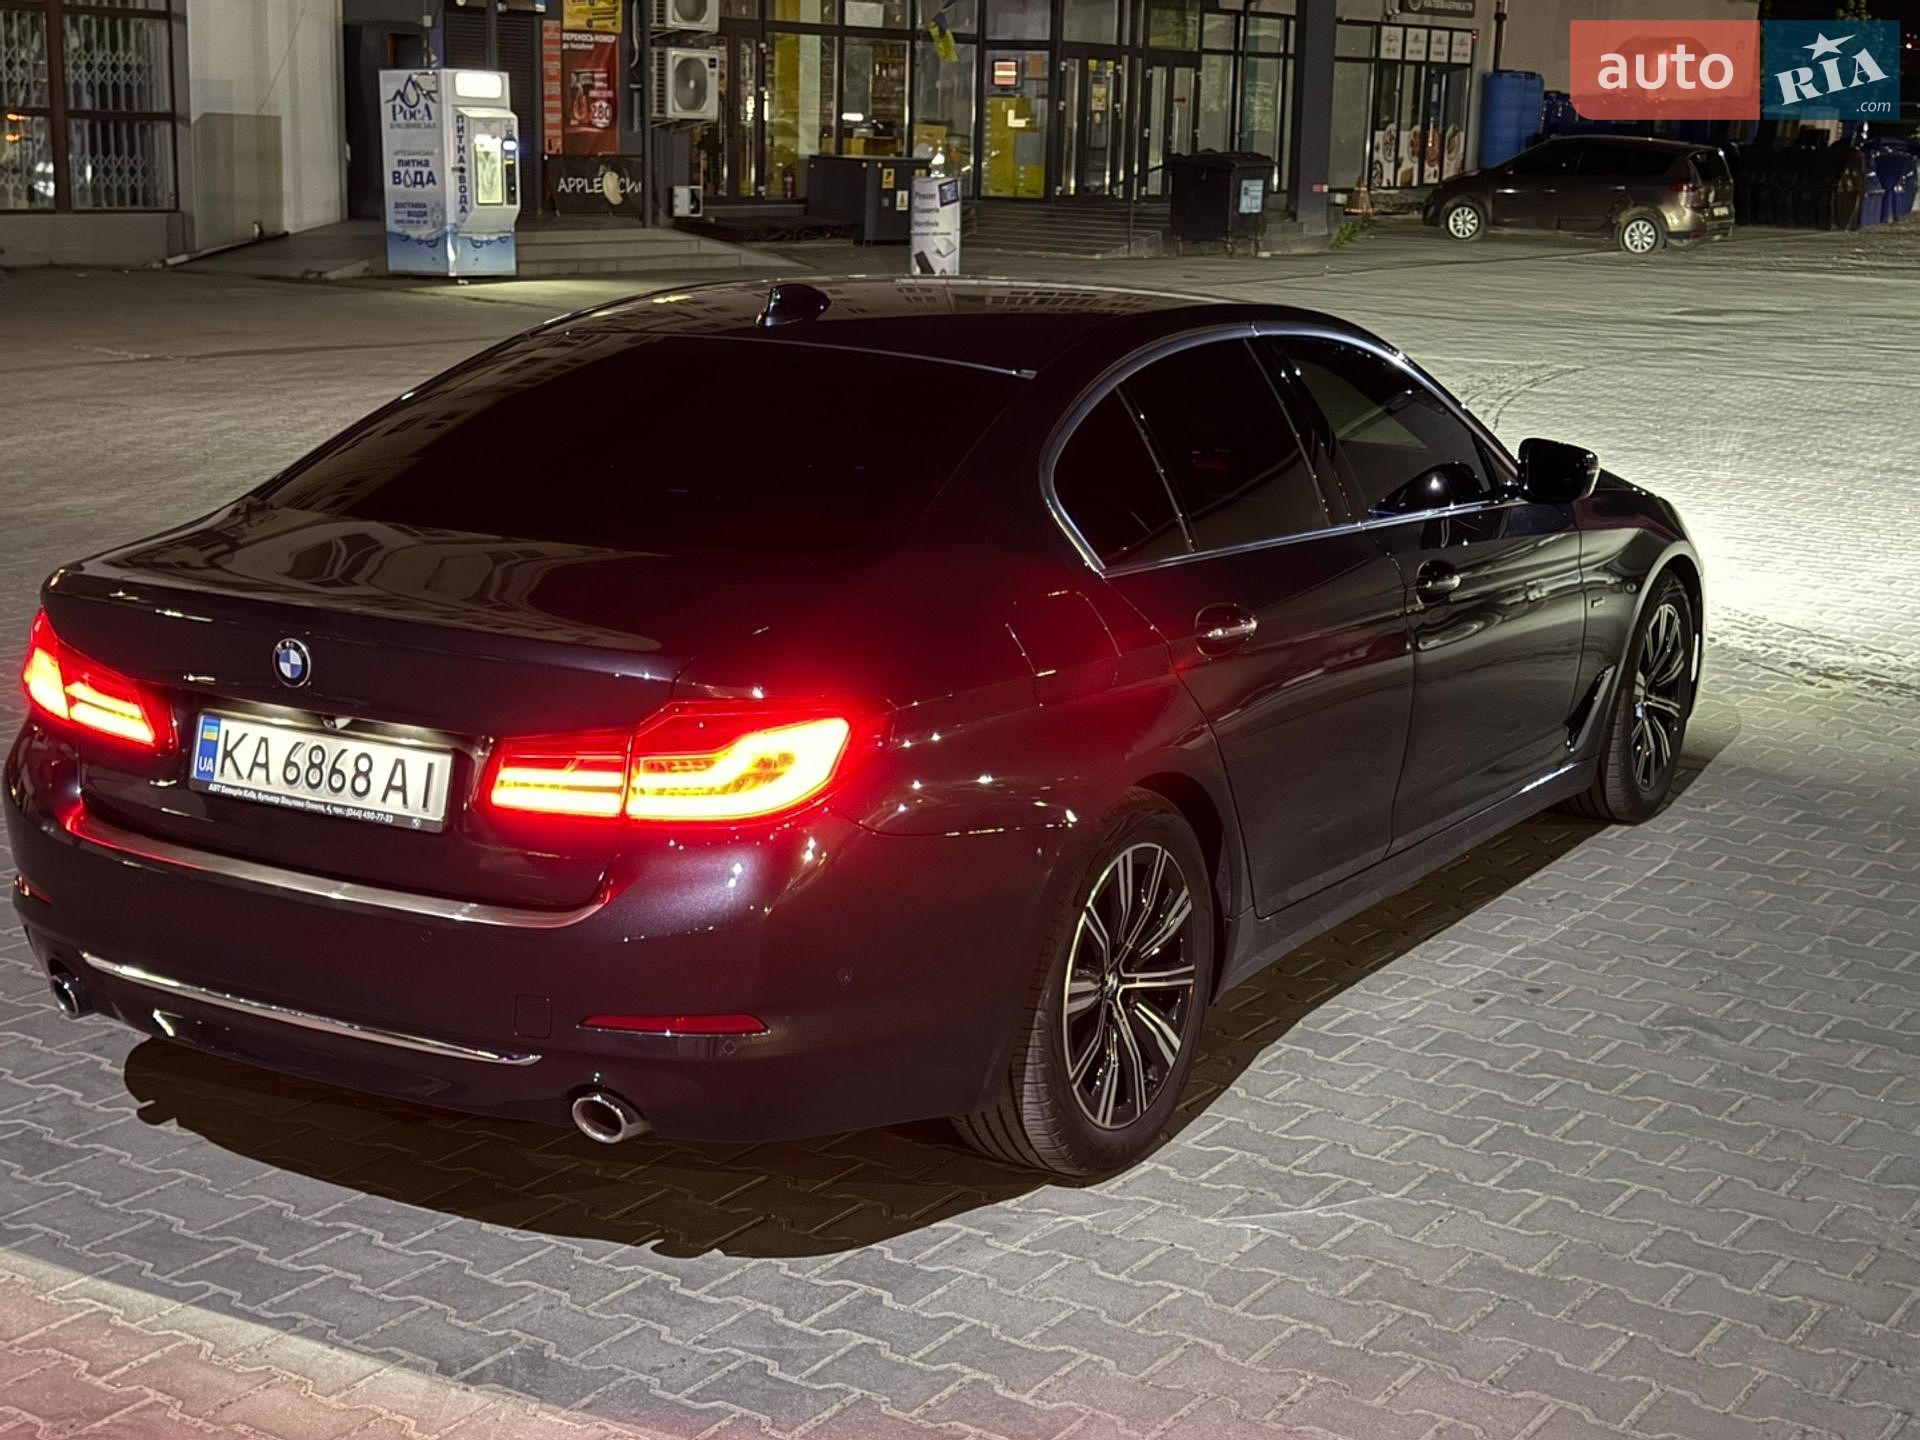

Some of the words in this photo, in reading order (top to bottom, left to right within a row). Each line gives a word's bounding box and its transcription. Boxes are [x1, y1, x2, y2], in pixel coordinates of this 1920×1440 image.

[456, 115, 466, 164] ПИТНА
[458, 174, 468, 214] ВОДА
[198, 755, 214, 773] UA
[219, 729, 272, 785] KA
[282, 741, 374, 798] 6868
[380, 758, 435, 812] AI
